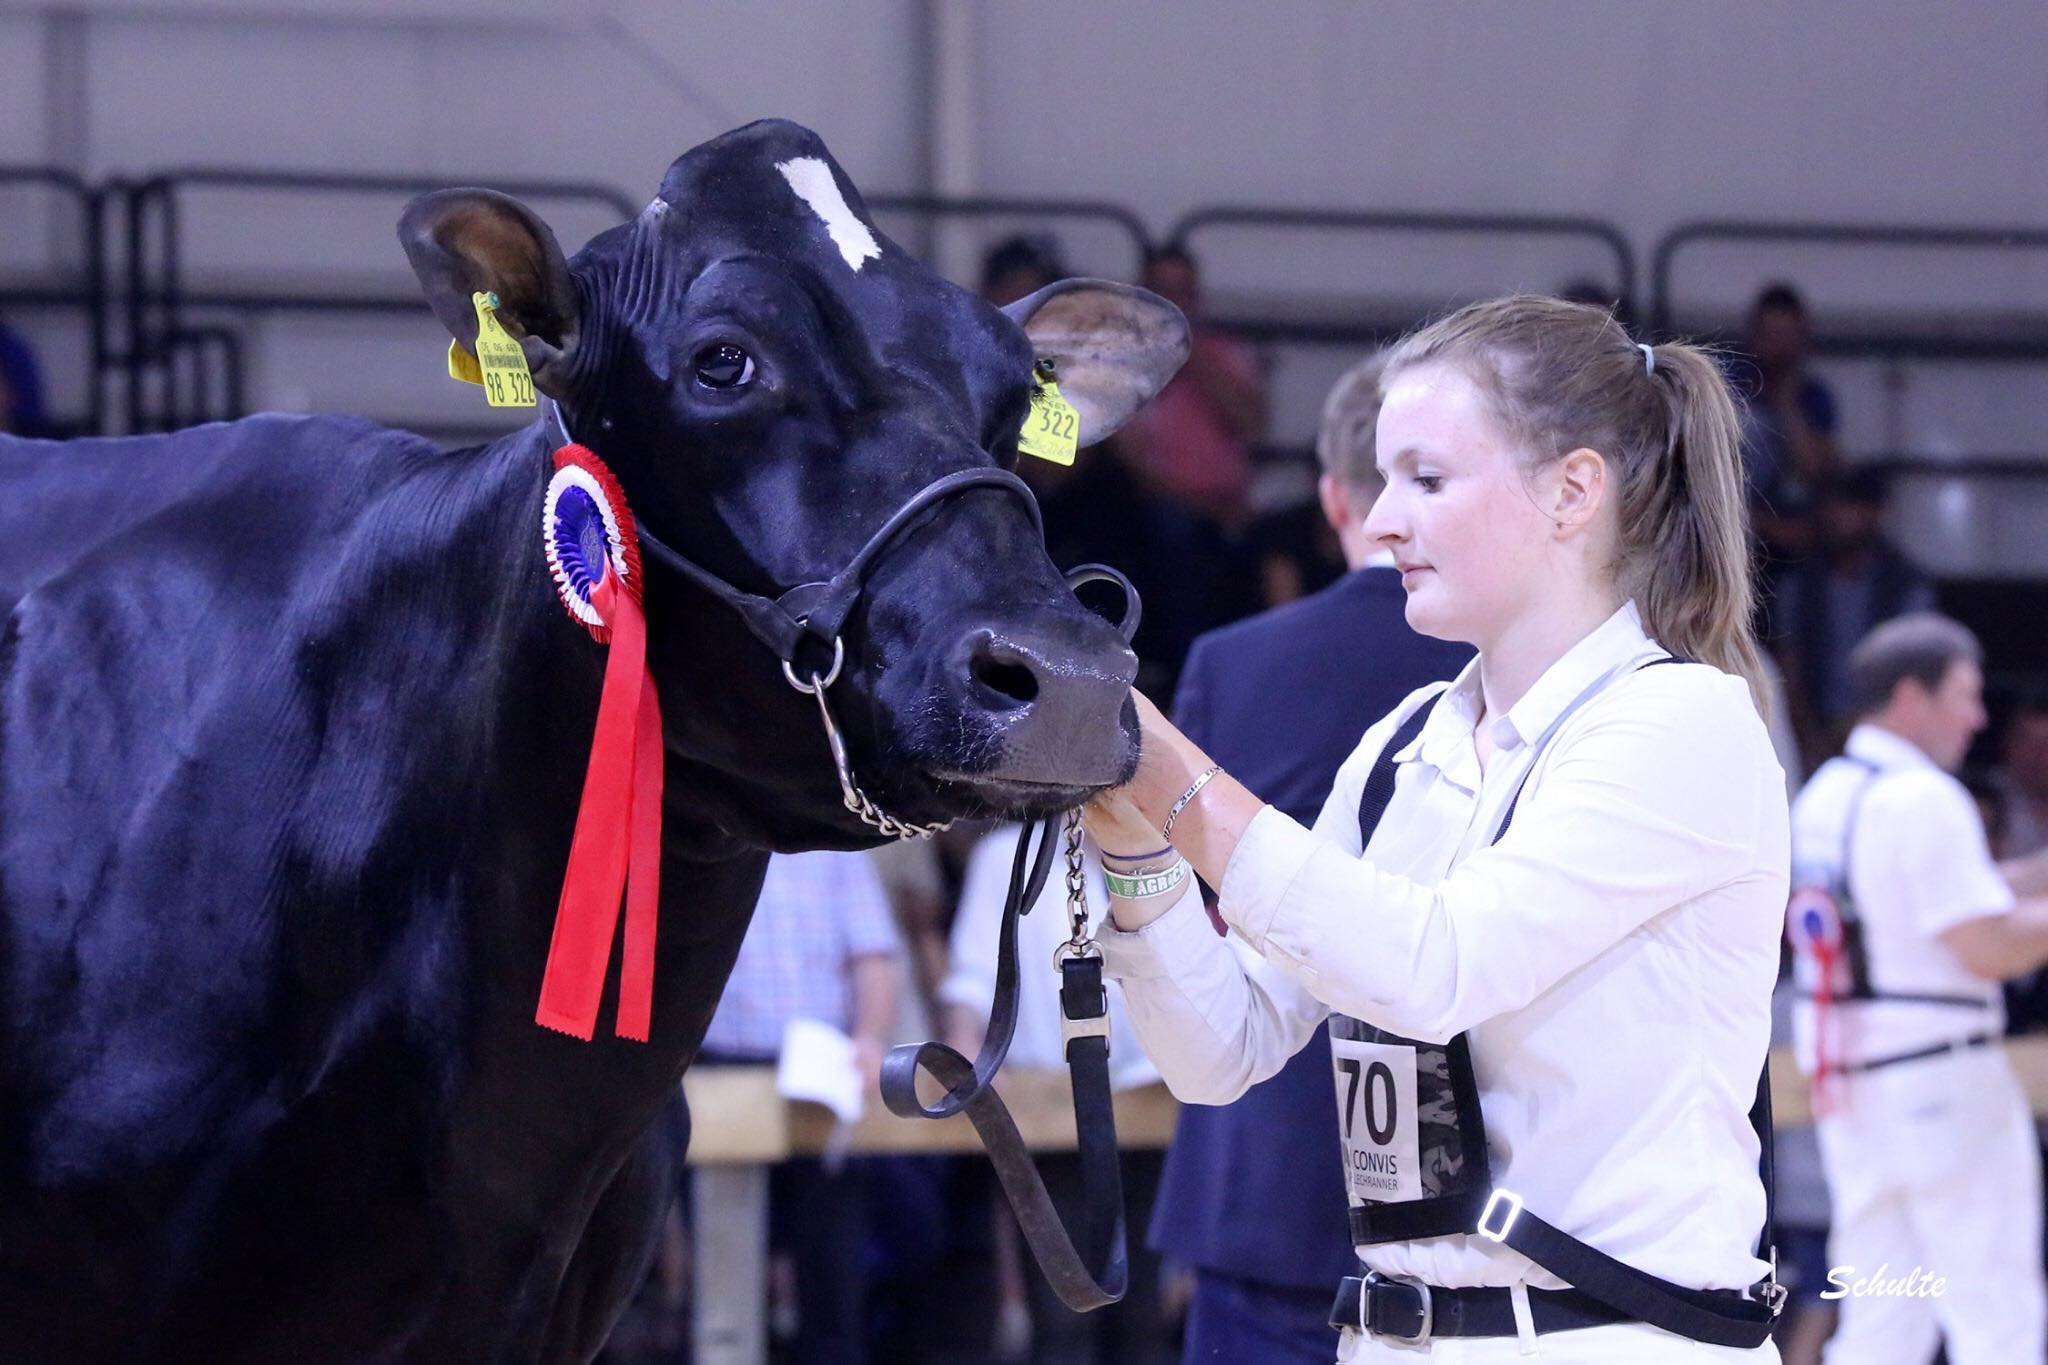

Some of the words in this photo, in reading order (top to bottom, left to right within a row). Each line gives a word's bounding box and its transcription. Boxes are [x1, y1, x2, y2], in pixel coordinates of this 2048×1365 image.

[486, 372, 505, 403] 98
[508, 372, 535, 403] 322
[1040, 406, 1075, 440] 322
[1336, 1057, 1398, 1146] 70
[1352, 1149, 1398, 1175] CONVIS
